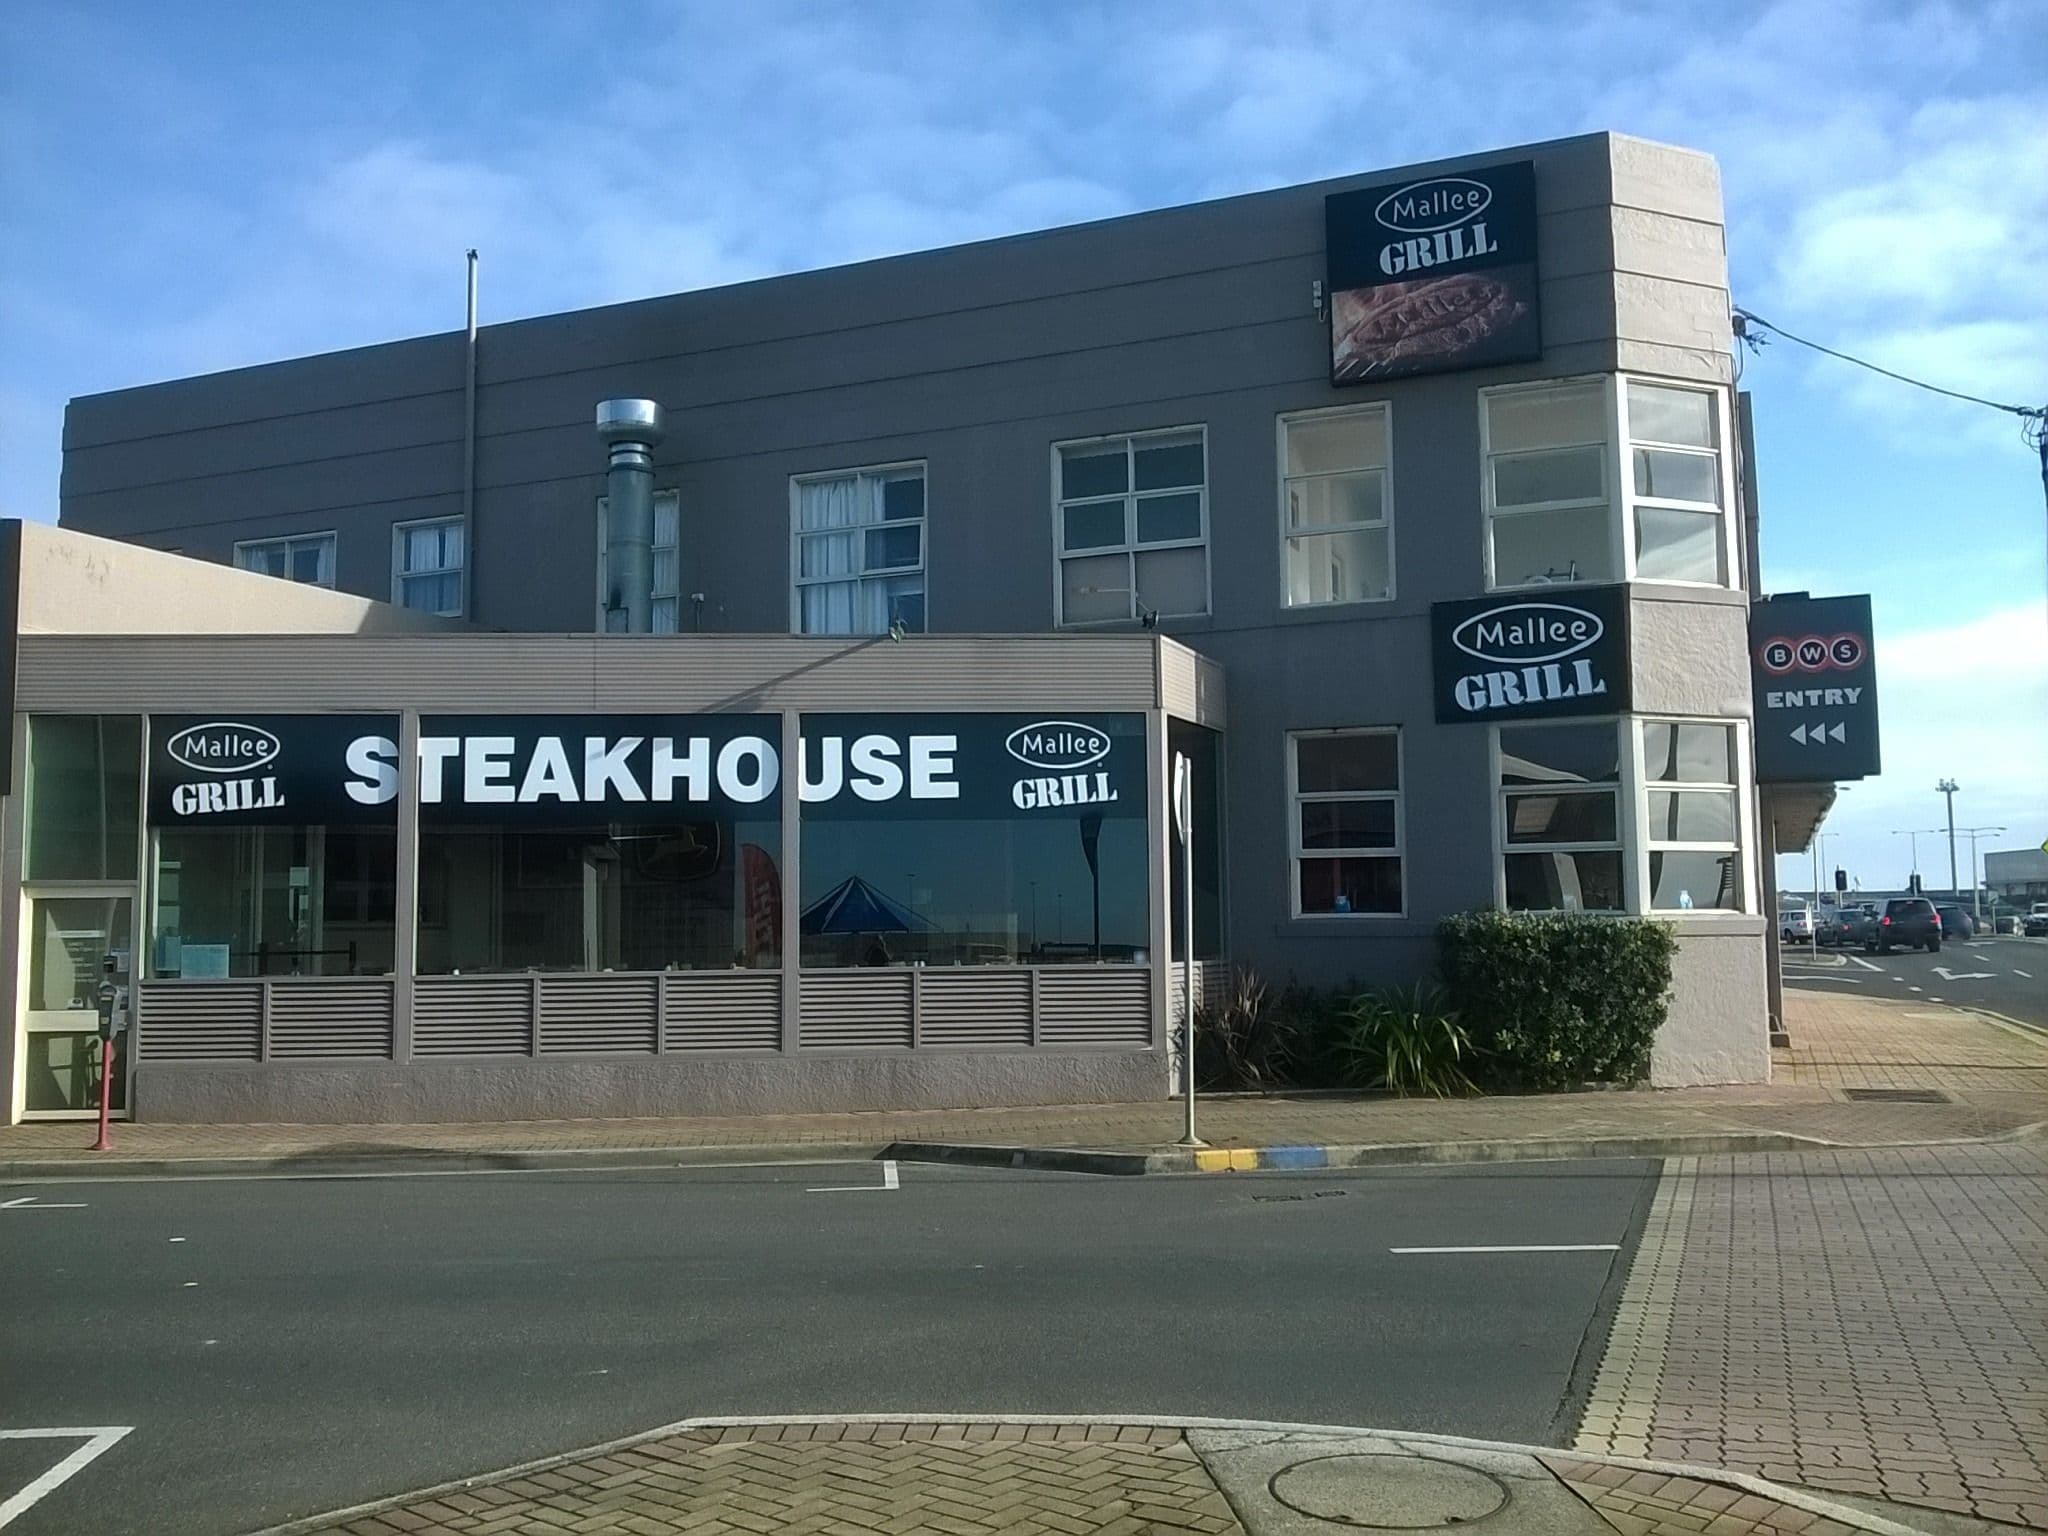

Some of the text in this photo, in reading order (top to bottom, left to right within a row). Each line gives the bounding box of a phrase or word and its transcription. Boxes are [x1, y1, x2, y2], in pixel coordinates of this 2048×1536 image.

[1393, 189, 1480, 223] Mallee
[1379, 222, 1498, 276] GRILL
[1475, 616, 1588, 650] Mallee
[1772, 642, 1854, 665] BWS
[1454, 658, 1608, 712] GRILL
[1766, 687, 1863, 709] ENTRY
[184, 734, 269, 759] Mallee
[1021, 732, 1101, 756] Mallee
[344, 734, 960, 806] STEAKHOUSE
[171, 776, 286, 816] GRILL
[1012, 771, 1119, 810] GRILL
